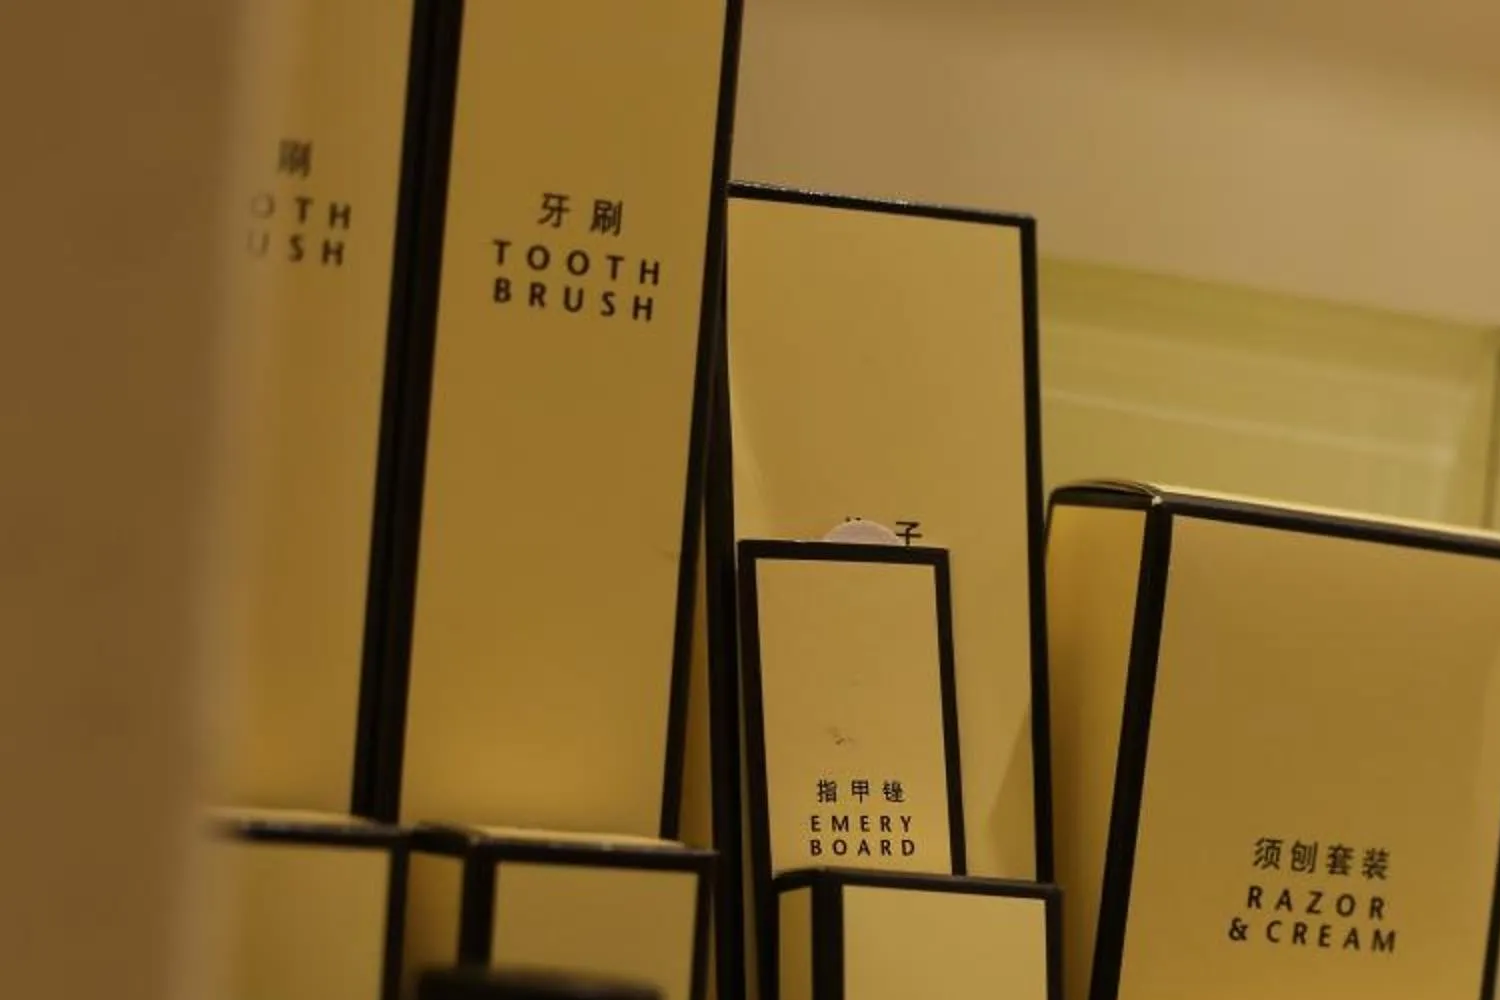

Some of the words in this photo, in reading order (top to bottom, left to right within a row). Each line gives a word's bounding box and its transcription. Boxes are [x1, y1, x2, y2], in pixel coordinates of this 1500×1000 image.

[538, 192, 624, 237] 牙刷
[492, 240, 661, 287] TOOTH
[493, 277, 654, 323] BRUSH
[810, 815, 913, 834] EMERY
[810, 839, 916, 857] BOARD
[1252, 836, 1390, 881] 须刨套装
[1246, 885, 1385, 921] RAZOR
